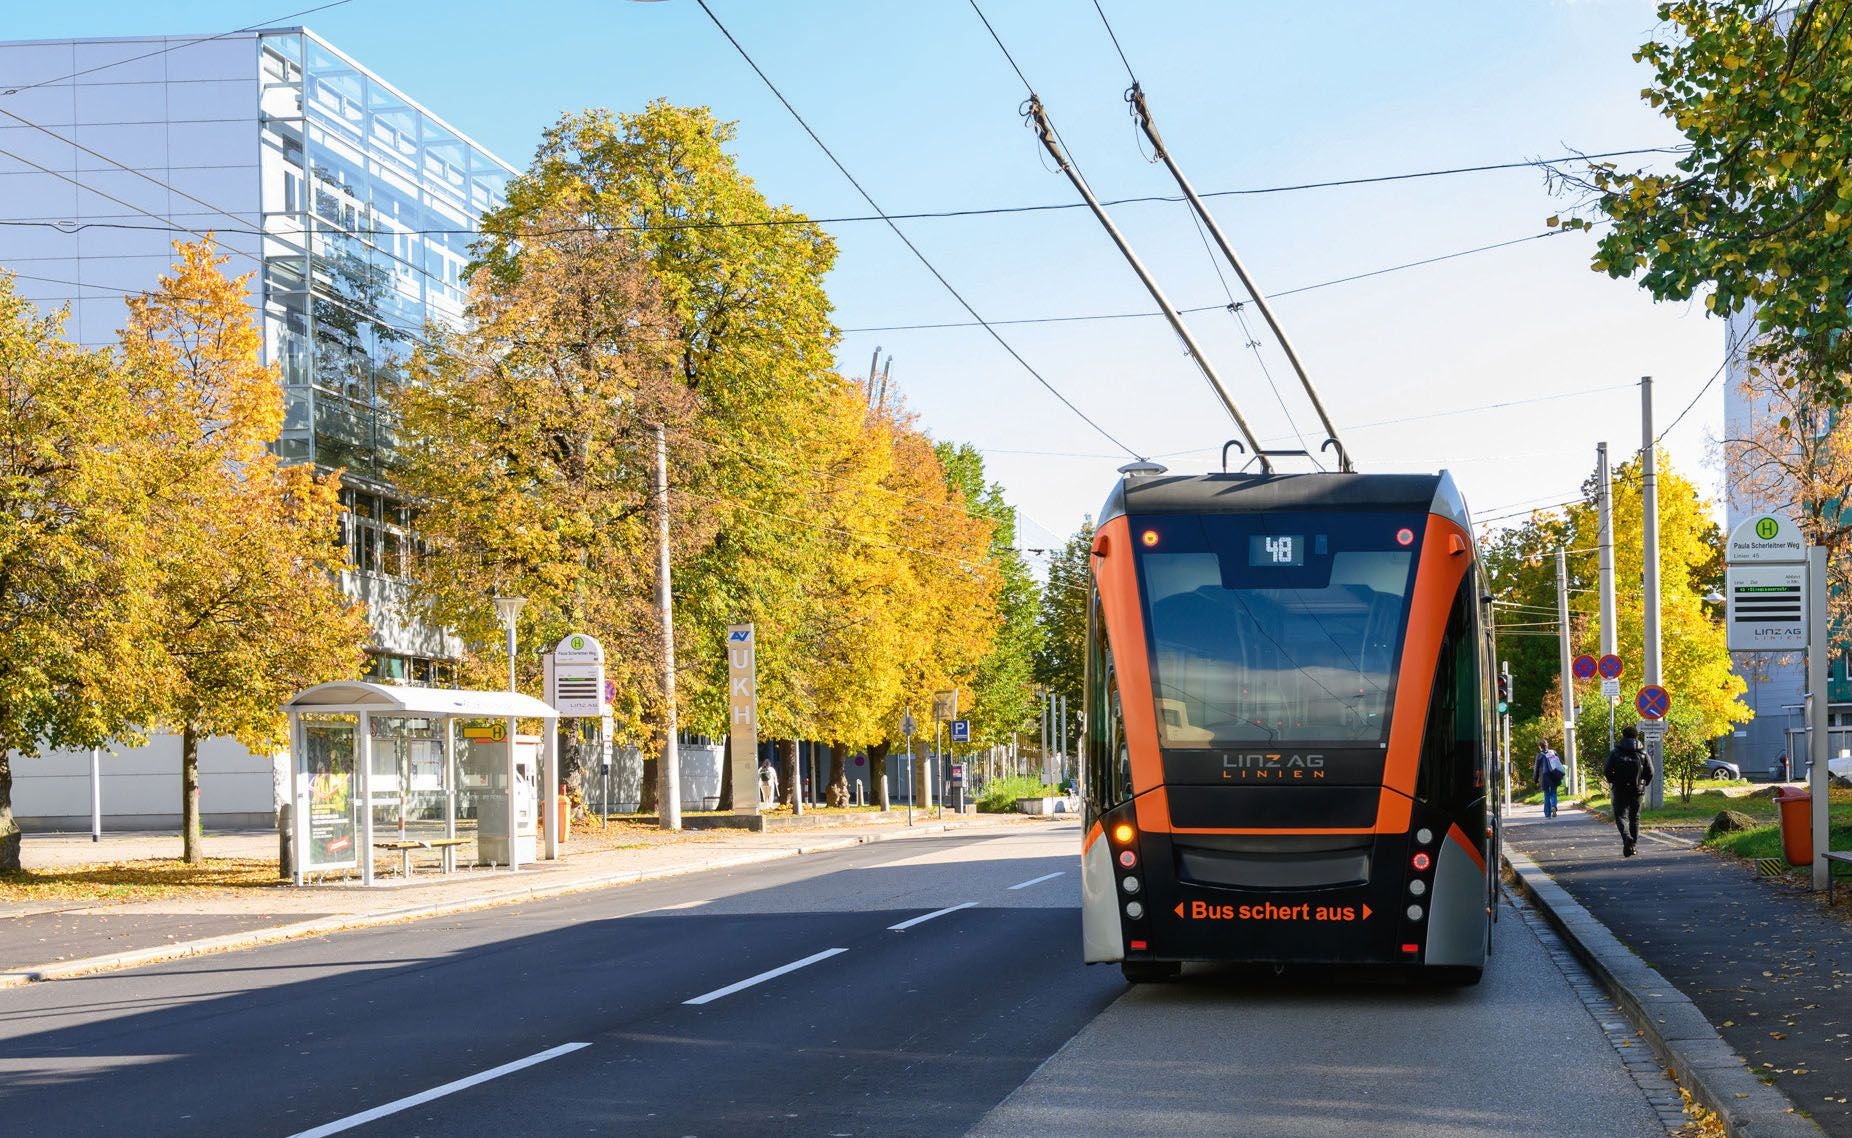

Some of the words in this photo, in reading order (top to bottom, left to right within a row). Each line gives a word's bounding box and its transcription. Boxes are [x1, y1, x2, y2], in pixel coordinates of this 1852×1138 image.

[1762, 522, 1773, 535] H
[1265, 537, 1292, 562] 48
[1787, 541, 1800, 549] Weg
[732, 649, 751, 725] UKH
[955, 722, 965, 735] P
[1223, 753, 1281, 768] LINZ
[1286, 754, 1325, 768] AG
[1222, 769, 1325, 779] LINIEN
[1191, 901, 1234, 920] Bus
[1238, 901, 1310, 920] schert
[1315, 904, 1356, 921] aus
